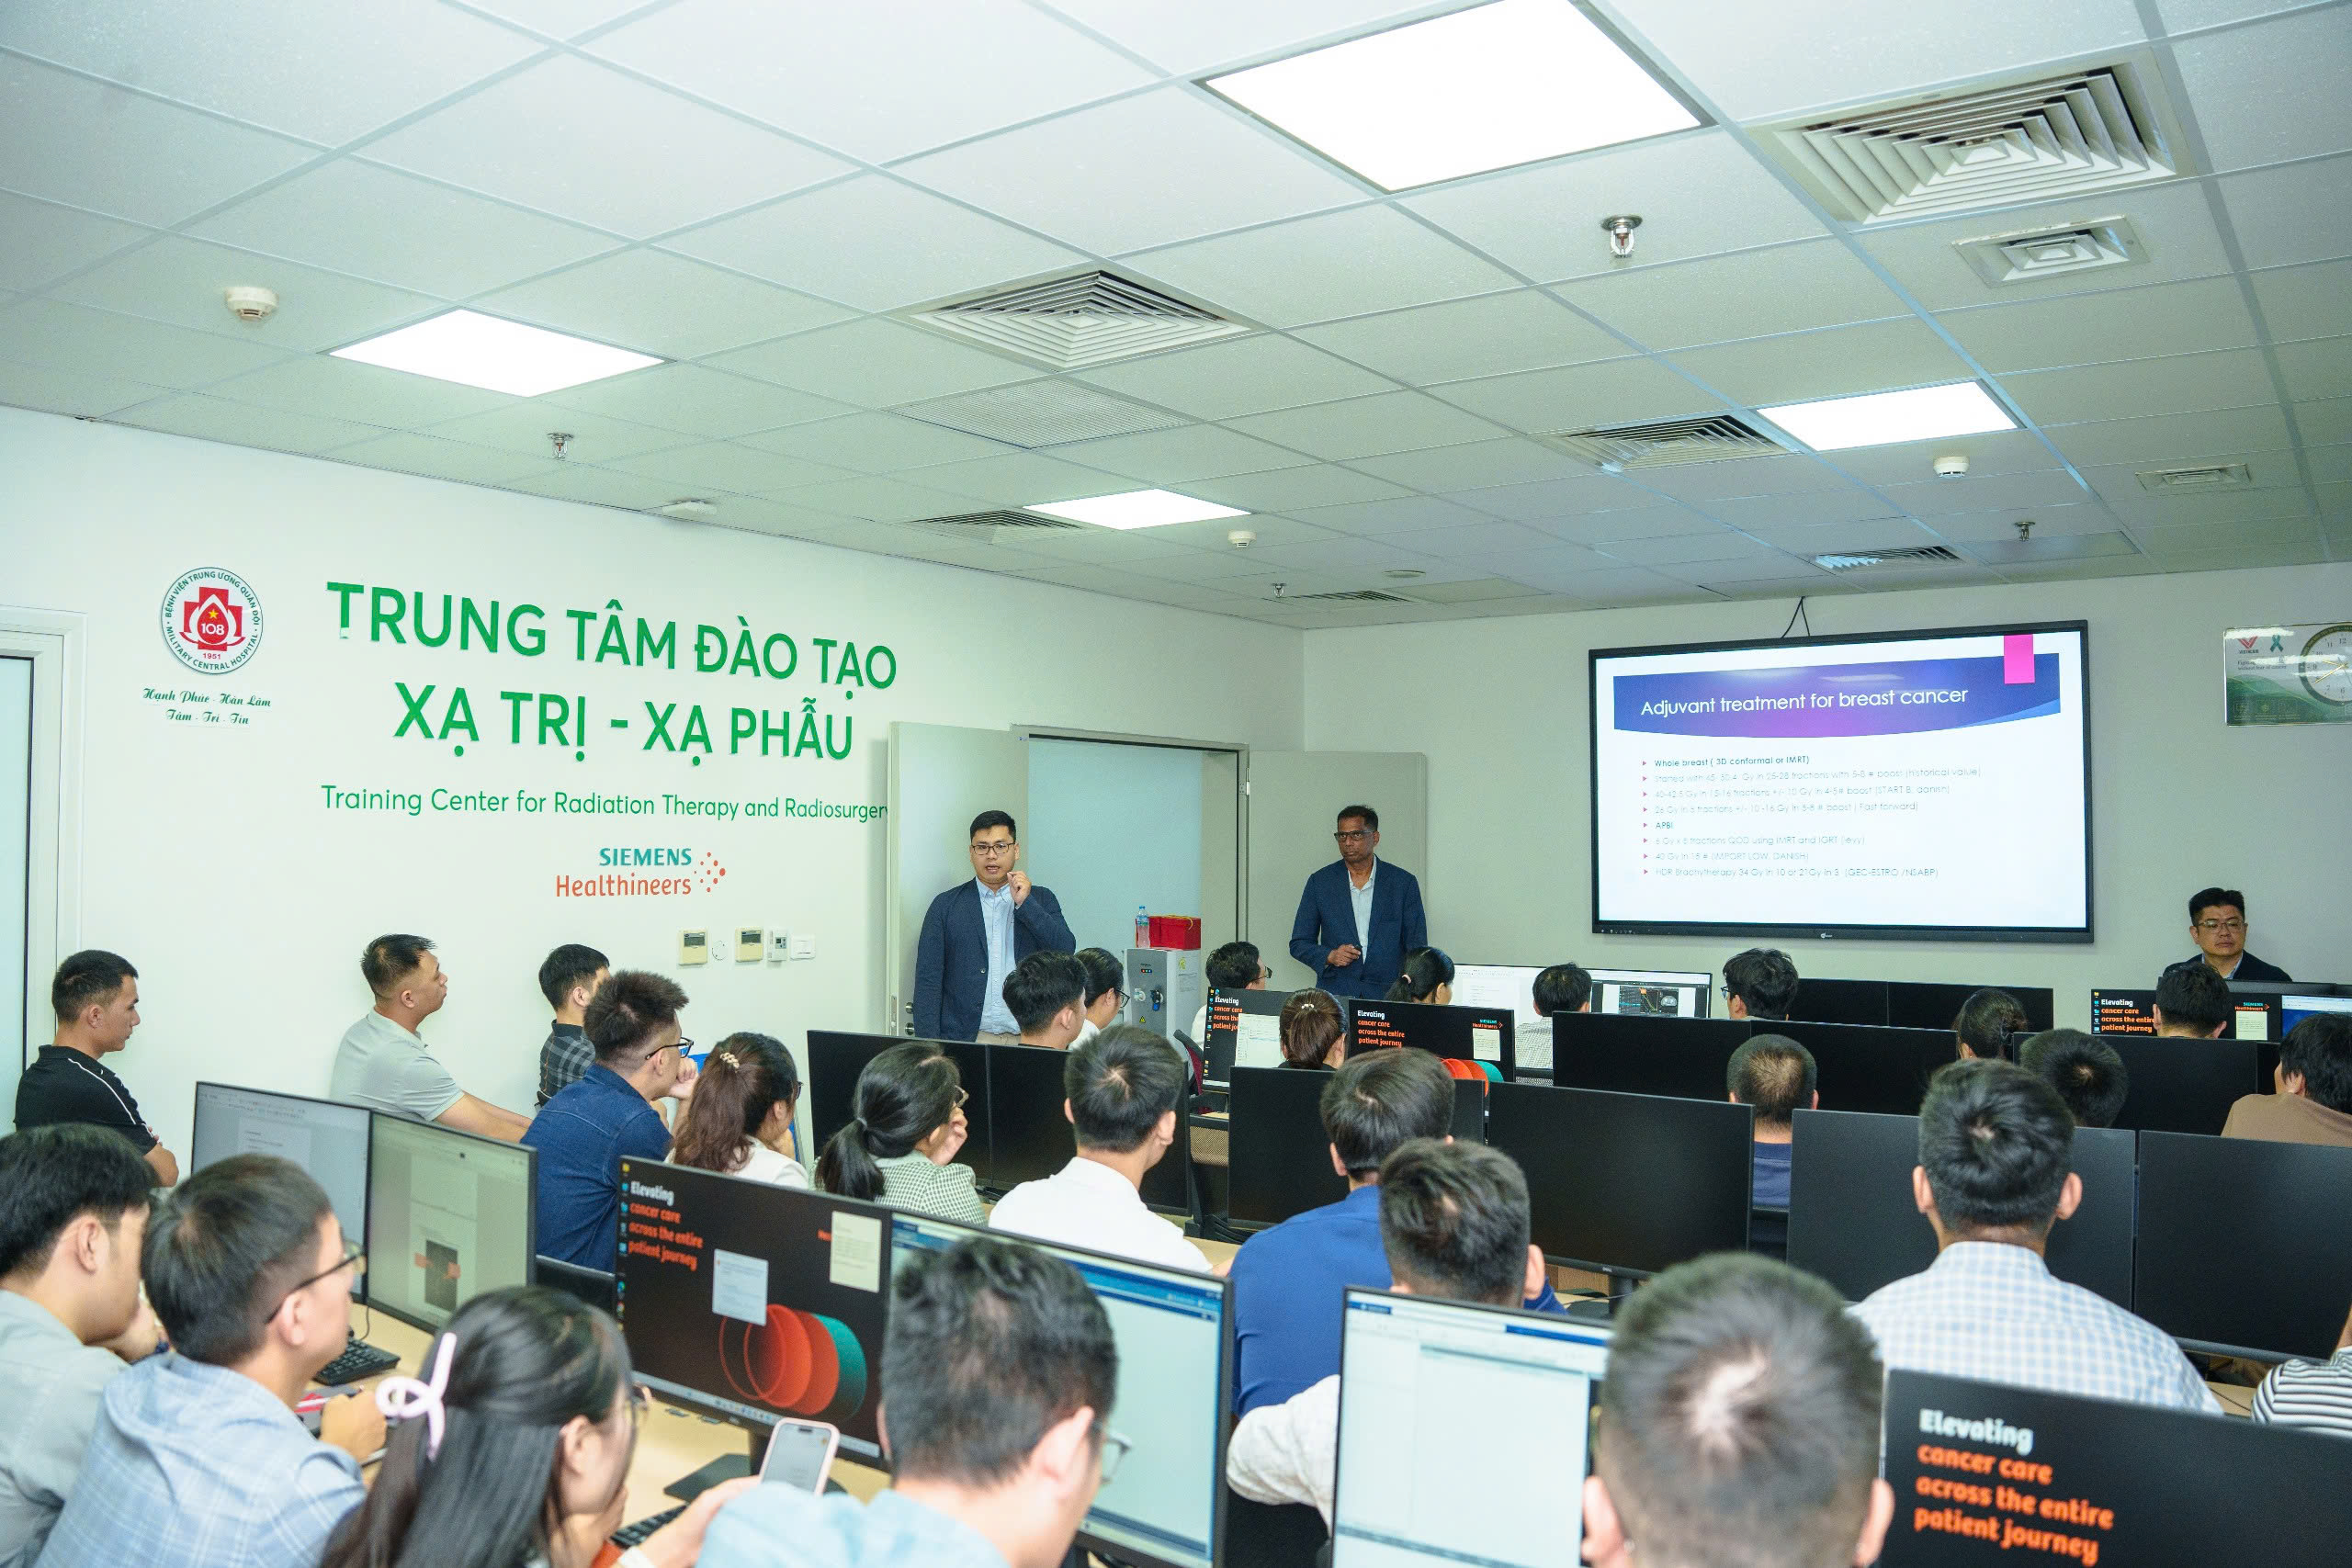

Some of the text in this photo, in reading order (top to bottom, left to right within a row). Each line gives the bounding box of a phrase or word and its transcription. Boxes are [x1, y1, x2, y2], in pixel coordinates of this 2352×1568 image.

[165, 571, 261, 626] BỆNH VIỆN TRUNG ƯƠNG QUÂN ĐỘI
[201, 623, 225, 636] 108
[326, 581, 898, 700] TRUNG TÂM ĐÀO TẠO
[166, 626, 258, 671] MILITARY CENTRAL HOSPITAL
[143, 688, 175, 701] Hạnh
[1641, 688, 1969, 718] Adjuvant treatment for breast cancer
[394, 681, 853, 766] XẠ TRỊ - XẠ PHẪU
[1655, 759, 1679, 767] Whole
[1682, 758, 1709, 766] breast
[1730, 756, 1773, 765] conformal
[1786, 755, 1810, 765] IMRT)
[322, 784, 422, 817] Training
[431, 787, 510, 814] Center
[516, 789, 547, 813] for
[554, 791, 655, 815] Radiation
[662, 794, 739, 821] Therapy
[744, 796, 779, 818] and
[598, 847, 692, 868] SIEMENS
[556, 871, 692, 897] Healthineers
[1215, 997, 1239, 1006] Elevating
[1357, 1010, 1385, 1020] Elevating
[2100, 998, 2133, 1008] Elevating
[2126, 1024, 2153, 1033] journey
[1358, 1037, 1402, 1048] patient journey
[630, 1180, 674, 1207] Elevating
[1919, 1408, 2033, 1456] Elevating
[1917, 1444, 2053, 1485] cancer care
[1916, 1475, 2114, 1530] across the entire
[1914, 1506, 2099, 1567] patient journey
